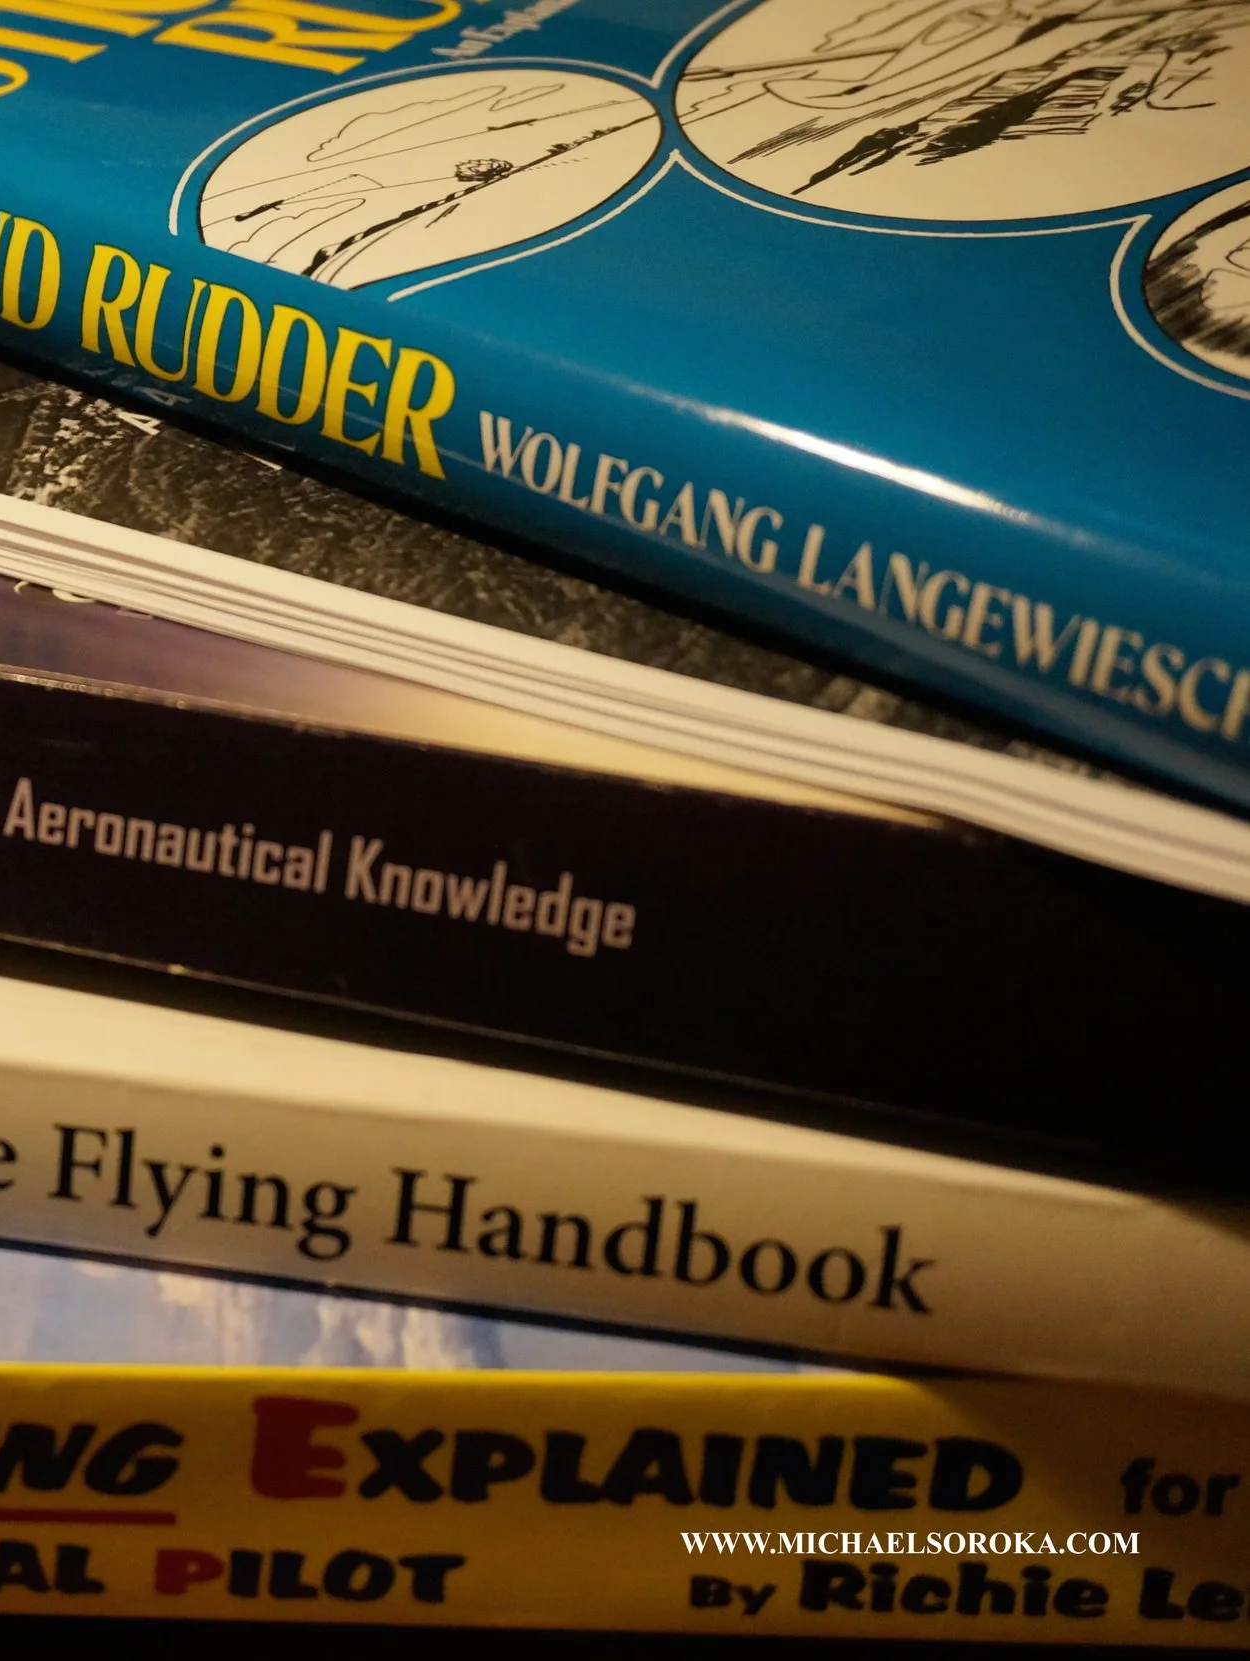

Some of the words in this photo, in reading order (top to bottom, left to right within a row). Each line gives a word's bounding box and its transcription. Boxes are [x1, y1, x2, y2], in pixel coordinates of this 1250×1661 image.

[80, 243, 456, 481] RUDDER
[479, 410, 784, 574] WOLFGANG
[2, 777, 333, 896] Aeronautical
[346, 834, 638, 958] Knowledge
[47, 1122, 358, 1260] Flying
[385, 1167, 937, 1316] Handbook
[249, 1394, 1024, 1513] EXPLAINED
[1120, 1457, 1241, 1517] for
[154, 1548, 467, 1604] PILOT
[799, 1558, 1110, 1619] Richie
[1138, 1566, 1250, 1622] Le
